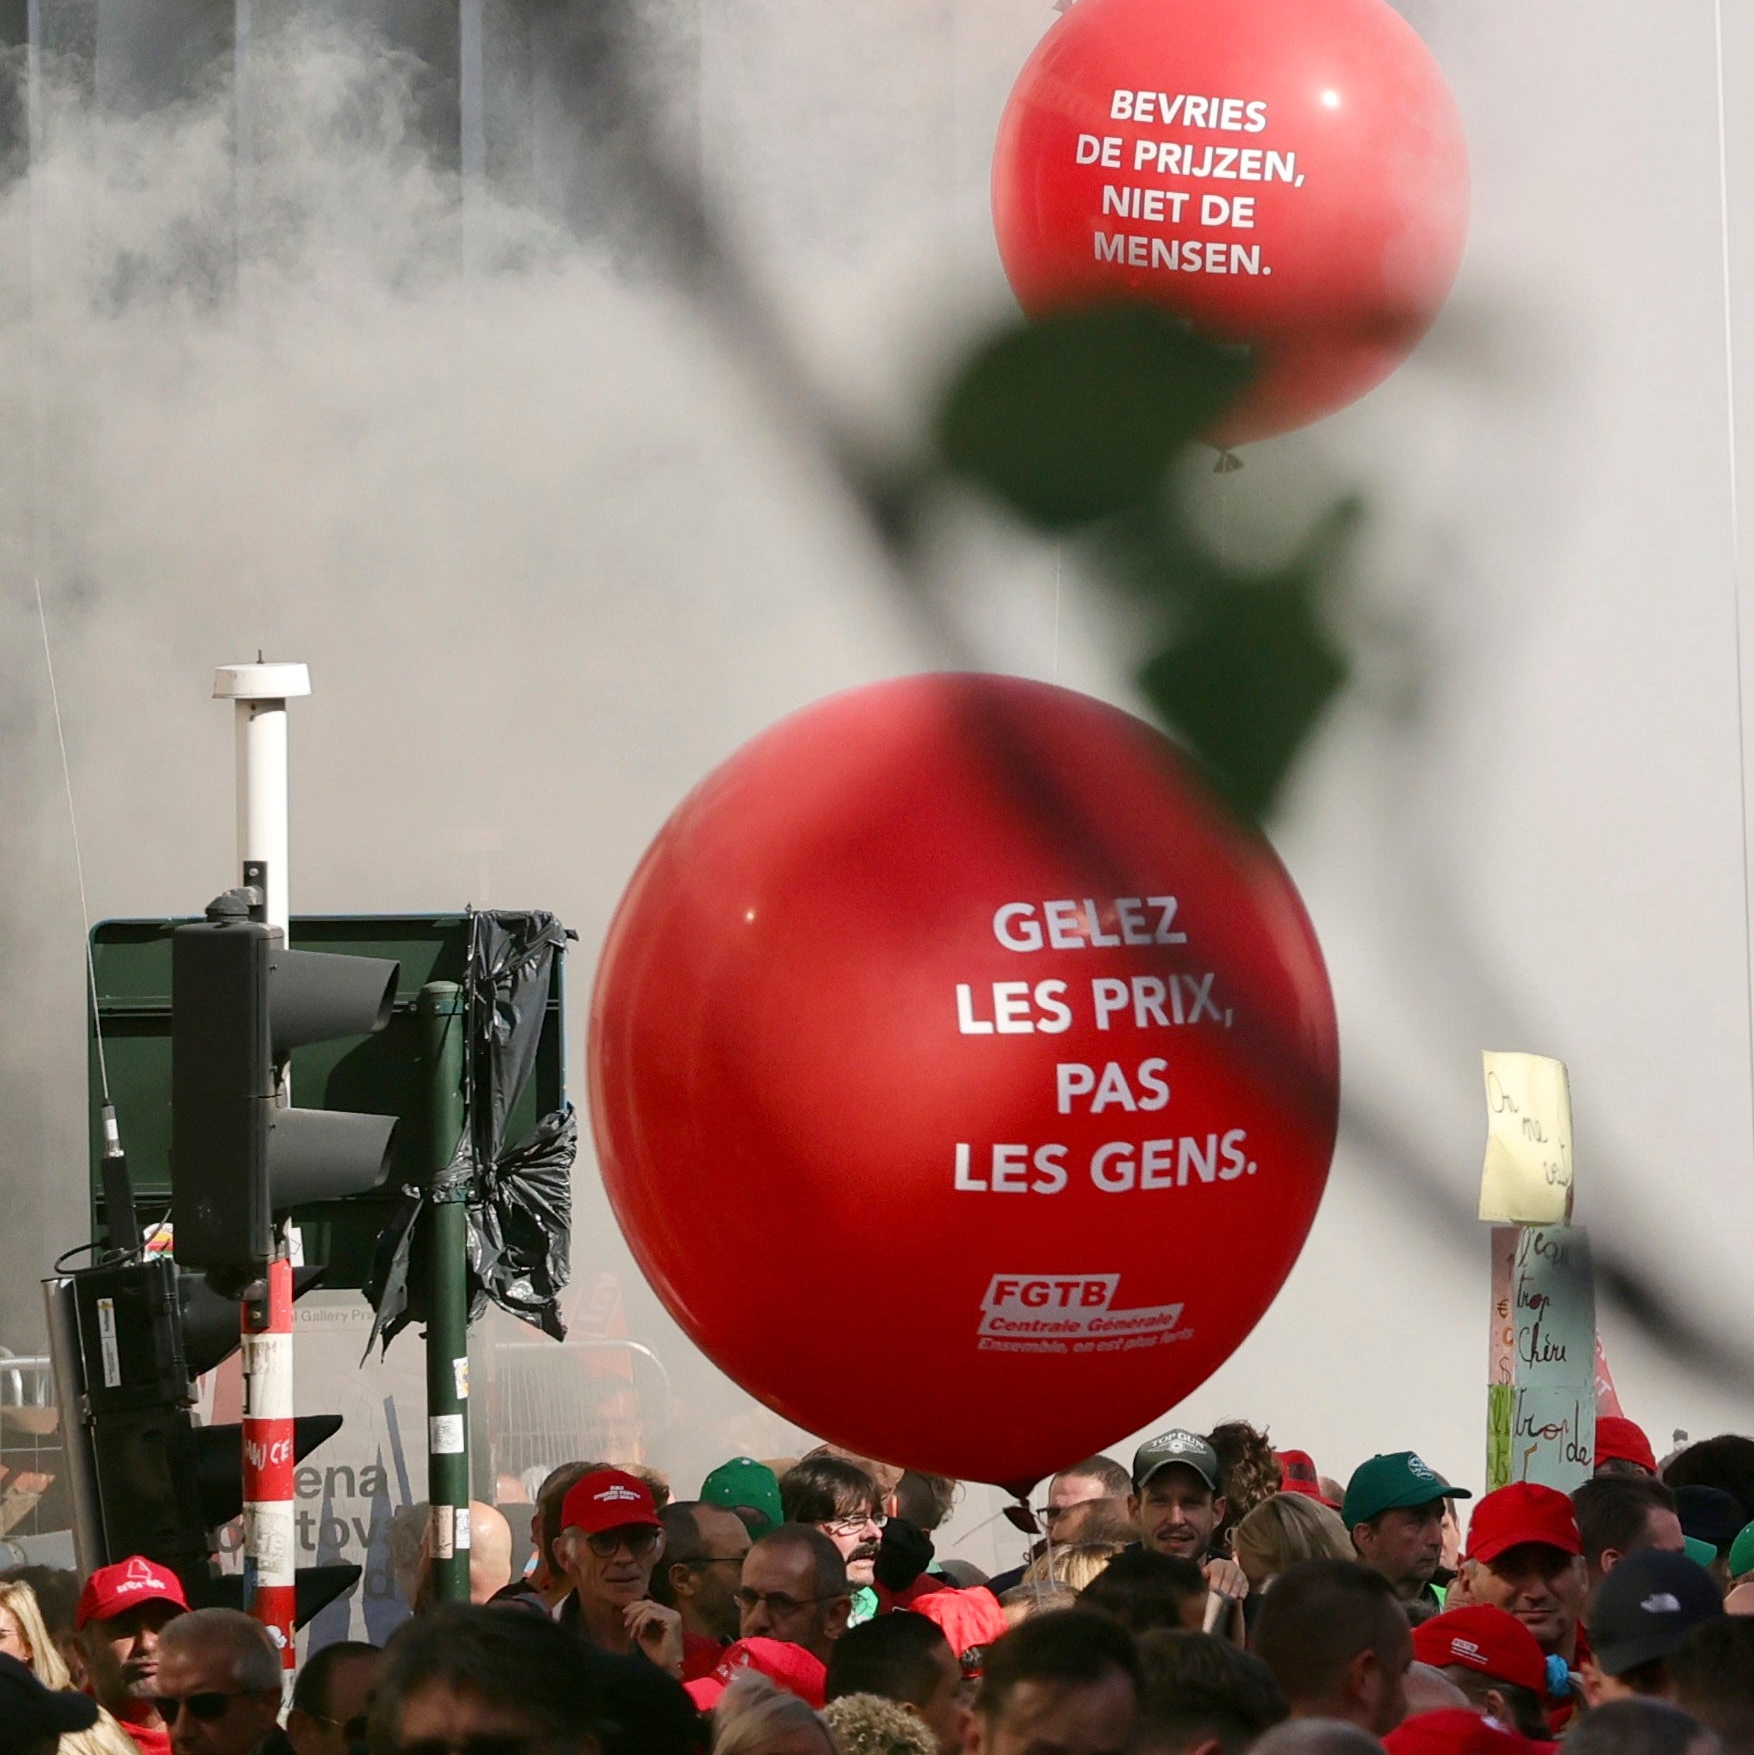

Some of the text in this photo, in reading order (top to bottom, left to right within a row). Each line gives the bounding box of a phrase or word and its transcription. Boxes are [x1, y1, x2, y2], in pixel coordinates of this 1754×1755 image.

[1110, 89, 1268, 133] BEVRIES
[1075, 133, 1305, 187] DE PRIJZEN,
[1102, 184, 1256, 229] NIET DE
[1093, 230, 1272, 276] MENSEN.
[992, 895, 1188, 953] GELEZ
[955, 972, 1234, 1035] LES PRIX,
[1056, 1057, 1171, 1115] PAS
[954, 1128, 1258, 1195] LES GENS.
[301, 1309, 348, 1324] Gallery
[992, 1280, 1108, 1308] FGTB
[988, 1316, 1082, 1334] Centrale
[1151, 1432, 1177, 1447] TOP
